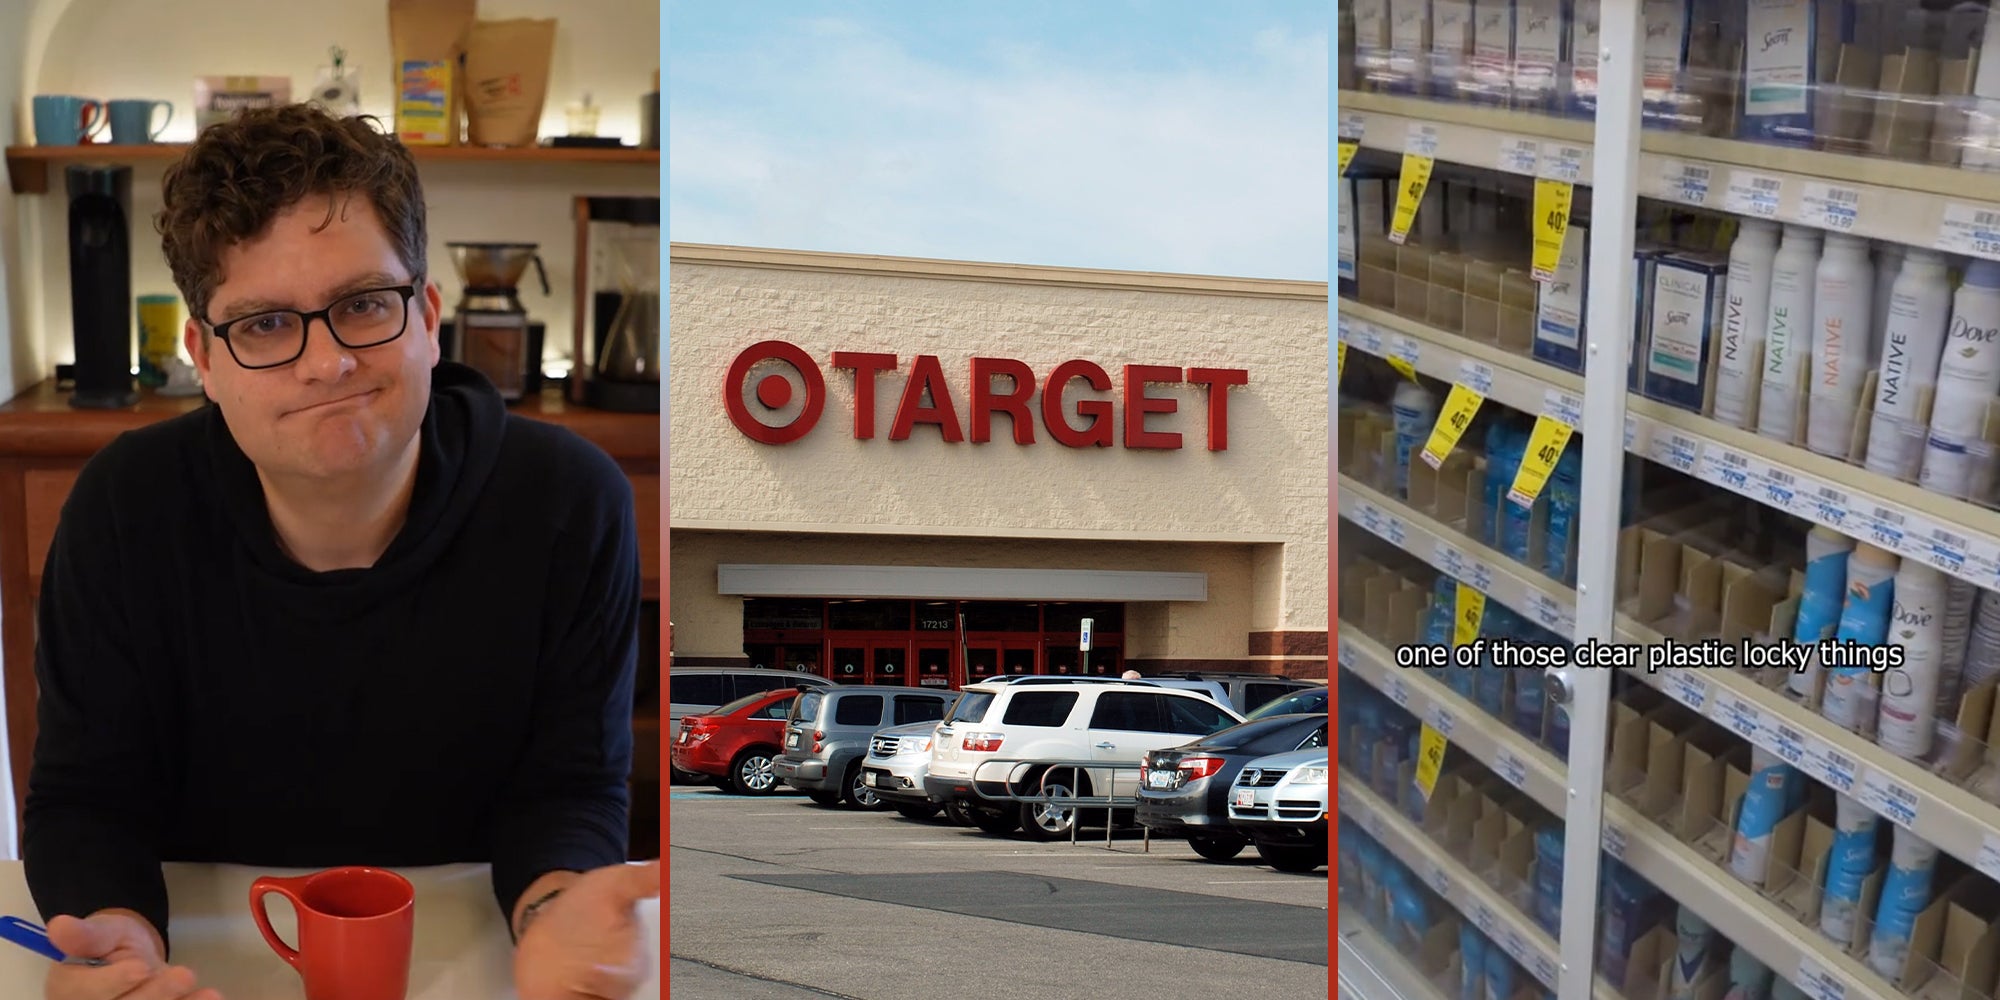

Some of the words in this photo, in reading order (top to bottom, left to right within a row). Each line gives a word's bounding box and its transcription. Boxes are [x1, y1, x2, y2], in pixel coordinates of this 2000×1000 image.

[1723, 294, 1744, 362] NATIVE
[1768, 306, 1789, 375] NATIVE
[1823, 316, 1843, 388] NATIVE
[1950, 315, 1999, 344] Dove
[831, 349, 1249, 453] TARGET
[1881, 331, 1907, 405] NATIVE
[922, 620, 949, 629] 17213
[1893, 600, 1933, 628] Dove
